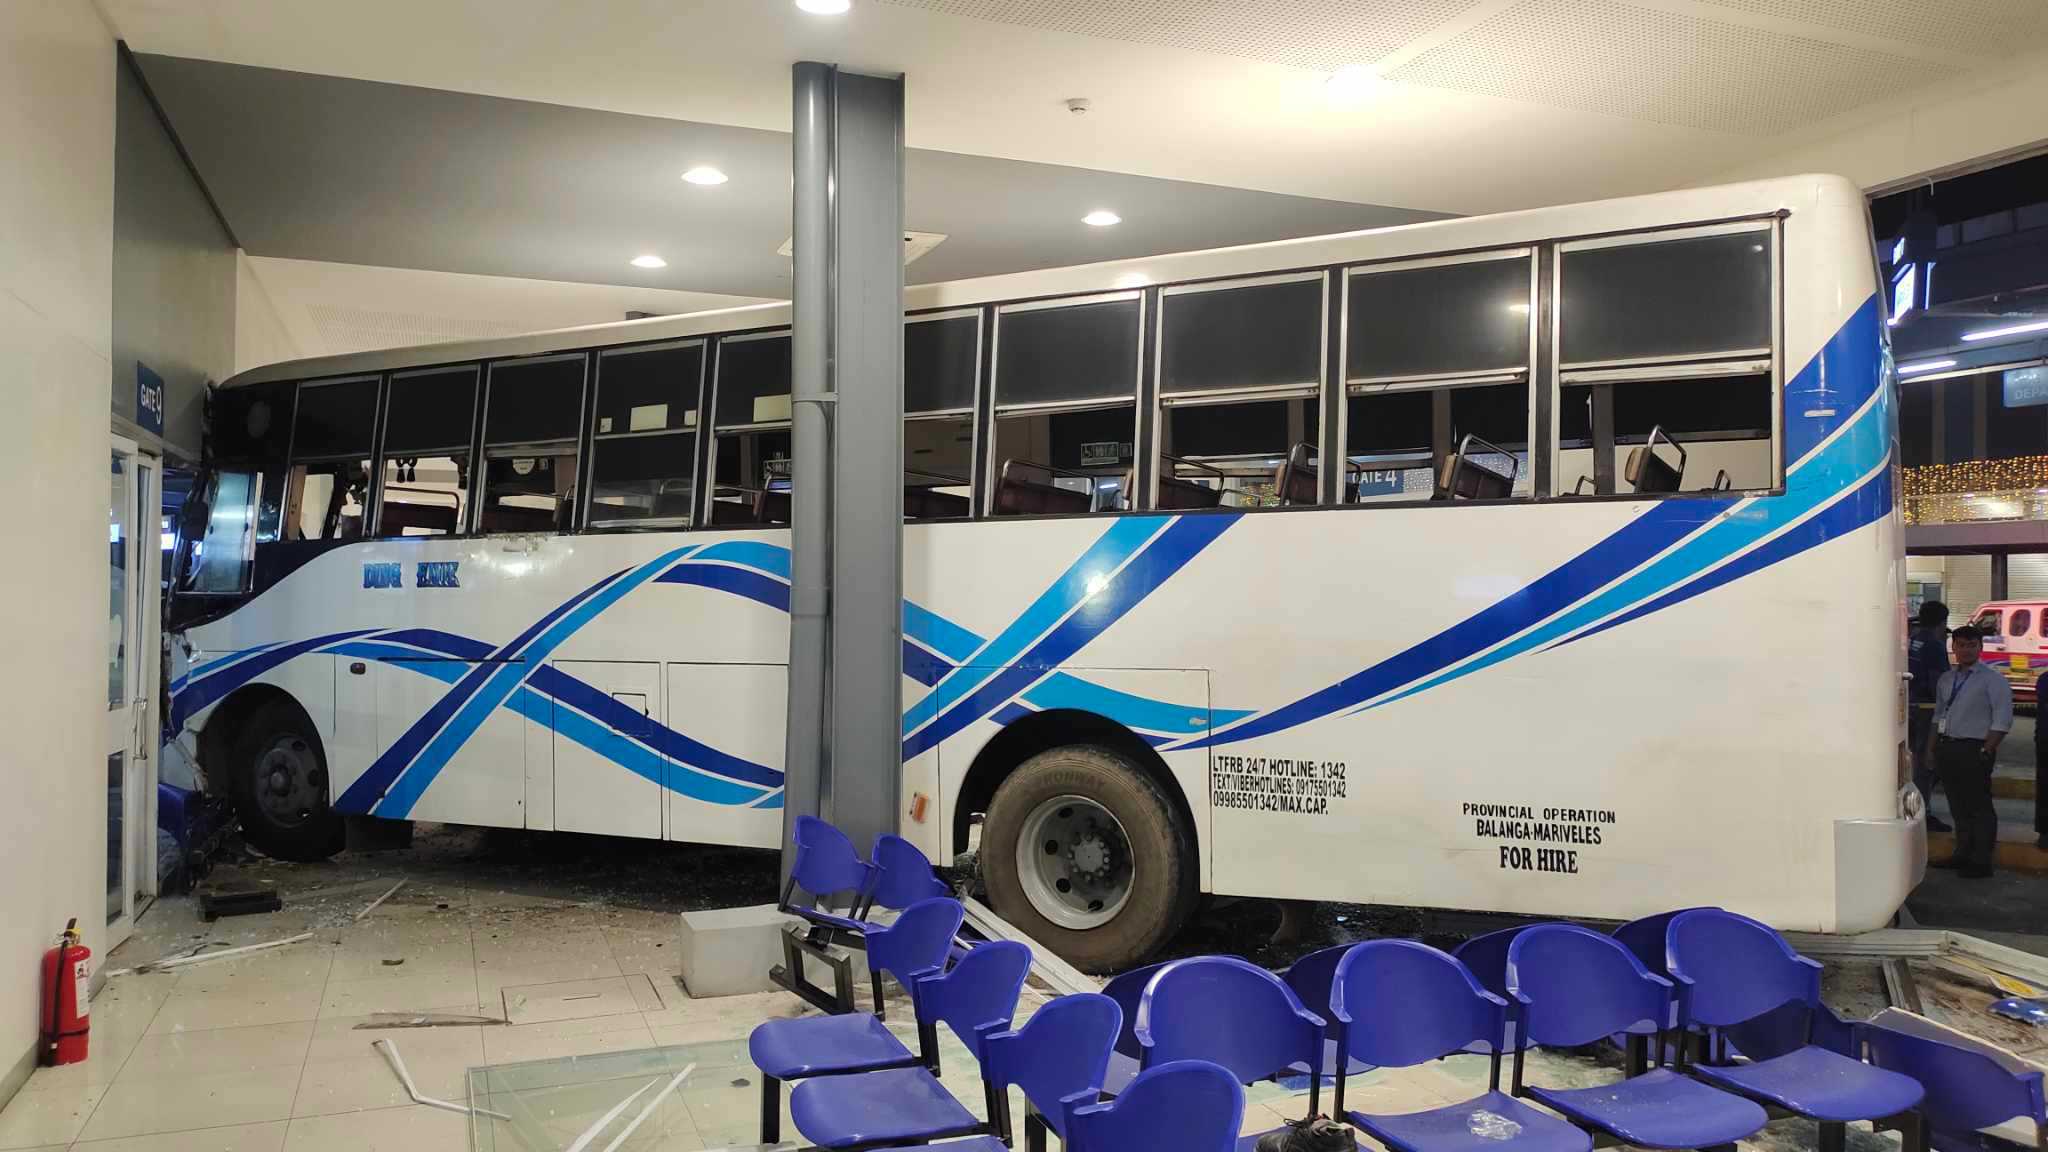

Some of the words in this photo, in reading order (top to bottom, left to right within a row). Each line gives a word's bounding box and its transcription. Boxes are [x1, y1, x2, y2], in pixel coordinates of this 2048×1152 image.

[141, 384, 156, 412] GATE
[156, 386, 162, 425] 9
[1385, 470, 1397, 488] 4
[1213, 755, 1243, 773] LTFRB
[1246, 757, 1266, 775] 24/7
[1269, 759, 1317, 778] HOTLINE:
[1320, 761, 1346, 779] 1342
[1296, 779, 1346, 798] 09175501342
[1463, 802, 1534, 819] PROVINCIAL
[1543, 808, 1616, 824] OPERATION
[1499, 846, 1533, 870] FOR
[1537, 848, 1578, 874] HIRE
